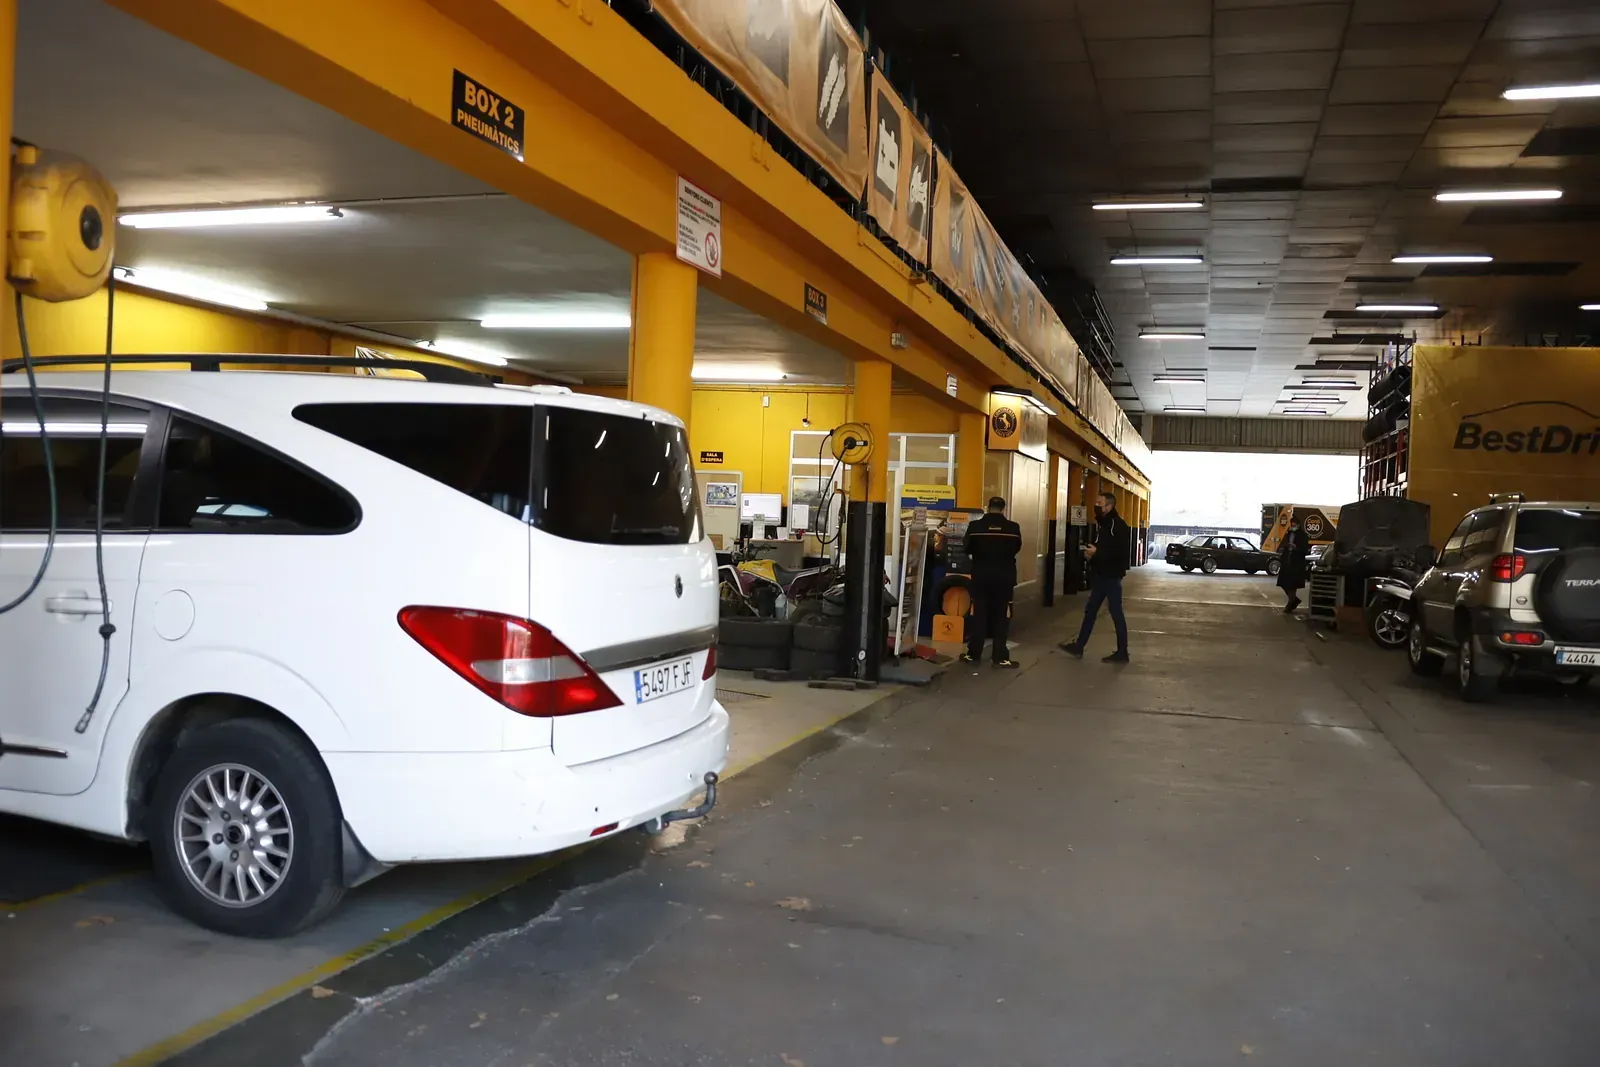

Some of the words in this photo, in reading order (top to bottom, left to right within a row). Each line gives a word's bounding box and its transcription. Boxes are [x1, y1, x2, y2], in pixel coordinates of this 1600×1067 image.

[465, 80, 500, 121] BOX
[504, 106, 515, 130] 2
[457, 108, 520, 154] PNEUMÀTICS
[808, 287, 820, 305] BOX
[820, 296, 825, 307] 3
[1307, 523, 1320, 531] 360
[1566, 654, 1596, 664] 4404
[642, 667, 670, 697] 5497
[673, 661, 690, 688] FJF
